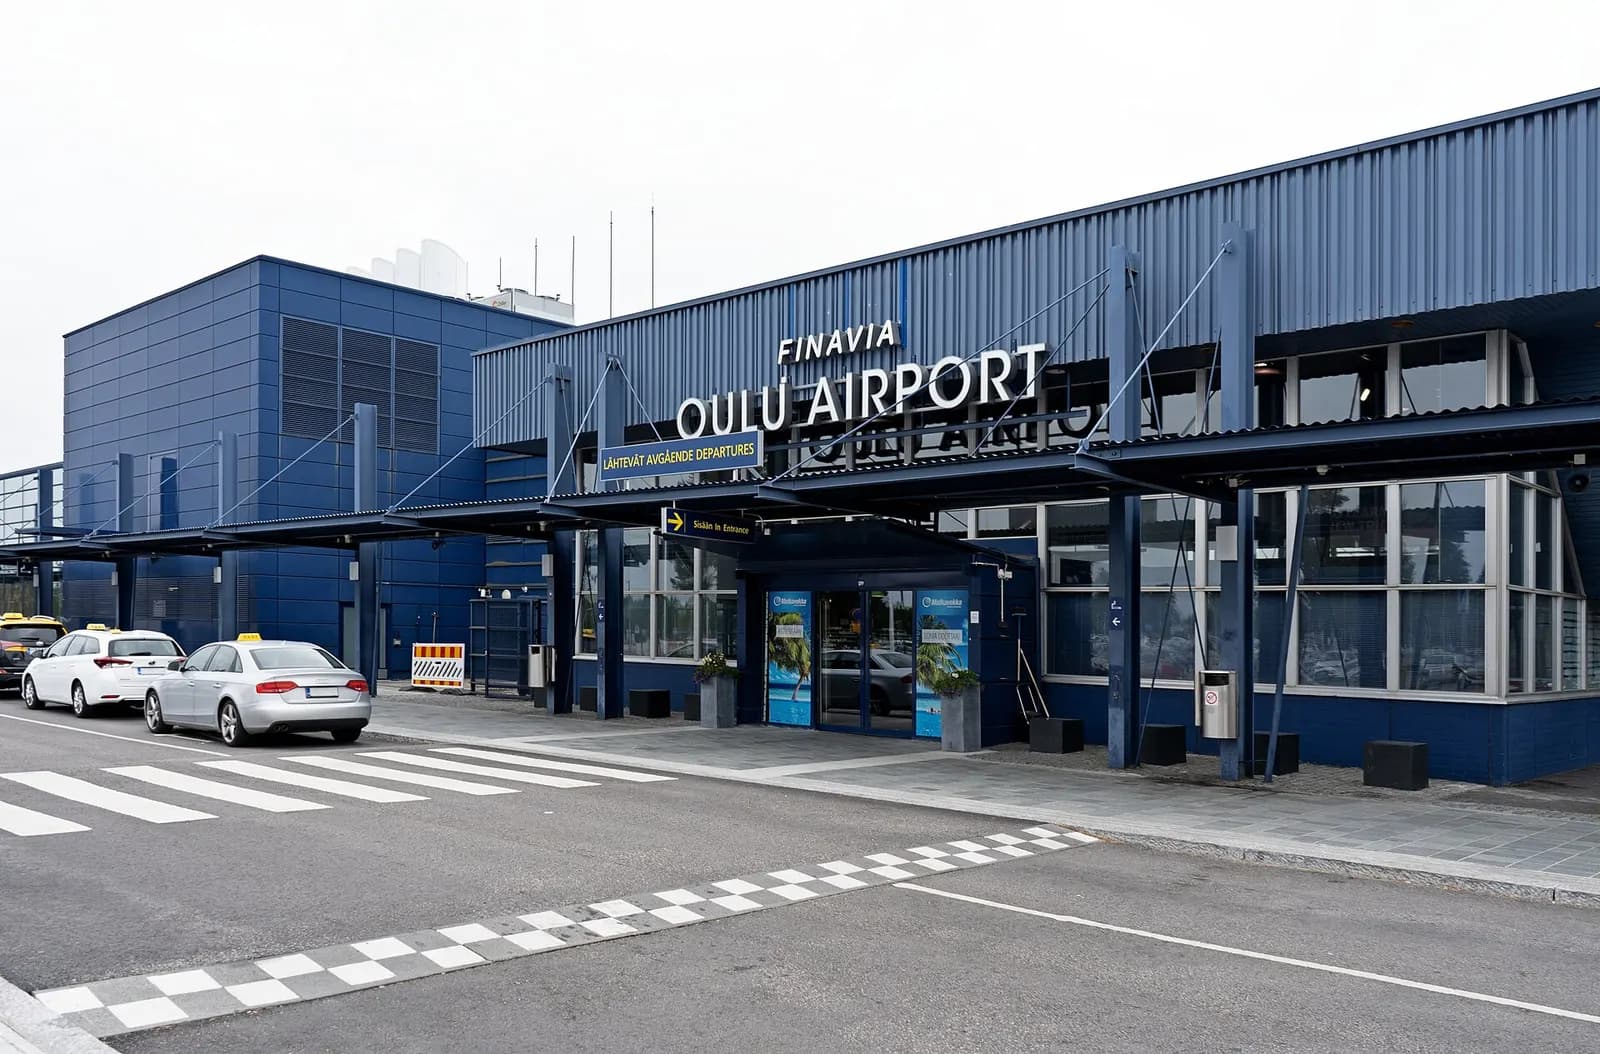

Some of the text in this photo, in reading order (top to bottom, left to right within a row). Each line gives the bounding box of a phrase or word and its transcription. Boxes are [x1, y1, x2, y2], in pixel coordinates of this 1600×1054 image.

[778, 319, 894, 365] FINAVIA
[677, 343, 1046, 440] OULU AIRPORT
[603, 443, 754, 470] LÄHTEVÄT AVGÅENDE DEPARTURES
[693, 520, 713, 530] Sisään
[723, 523, 749, 534] Entrance
